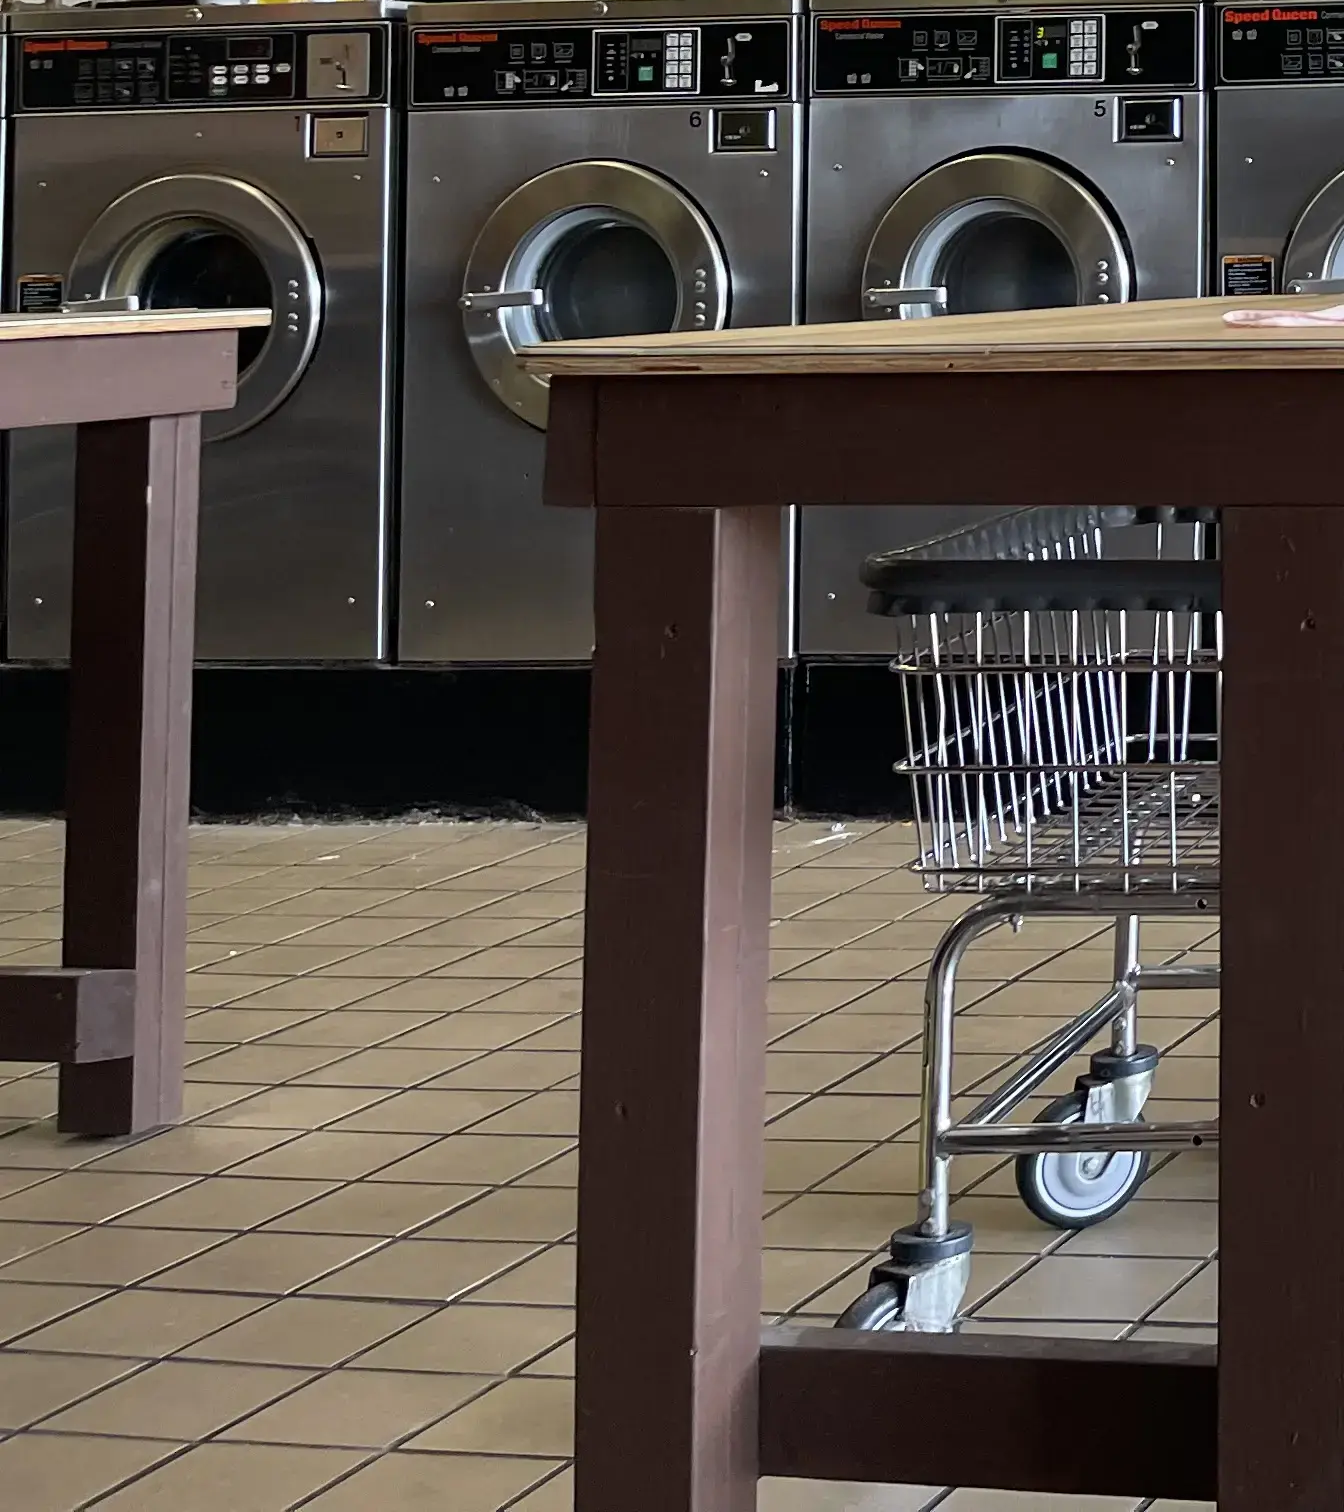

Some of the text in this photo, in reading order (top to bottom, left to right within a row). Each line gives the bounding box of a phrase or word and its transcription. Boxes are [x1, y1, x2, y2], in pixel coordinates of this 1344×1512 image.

[1225, 9, 1269, 24] Speed
[1272, 8, 1317, 20] Queen
[1094, 100, 1106, 117] 5
[689, 111, 702, 127] 6
